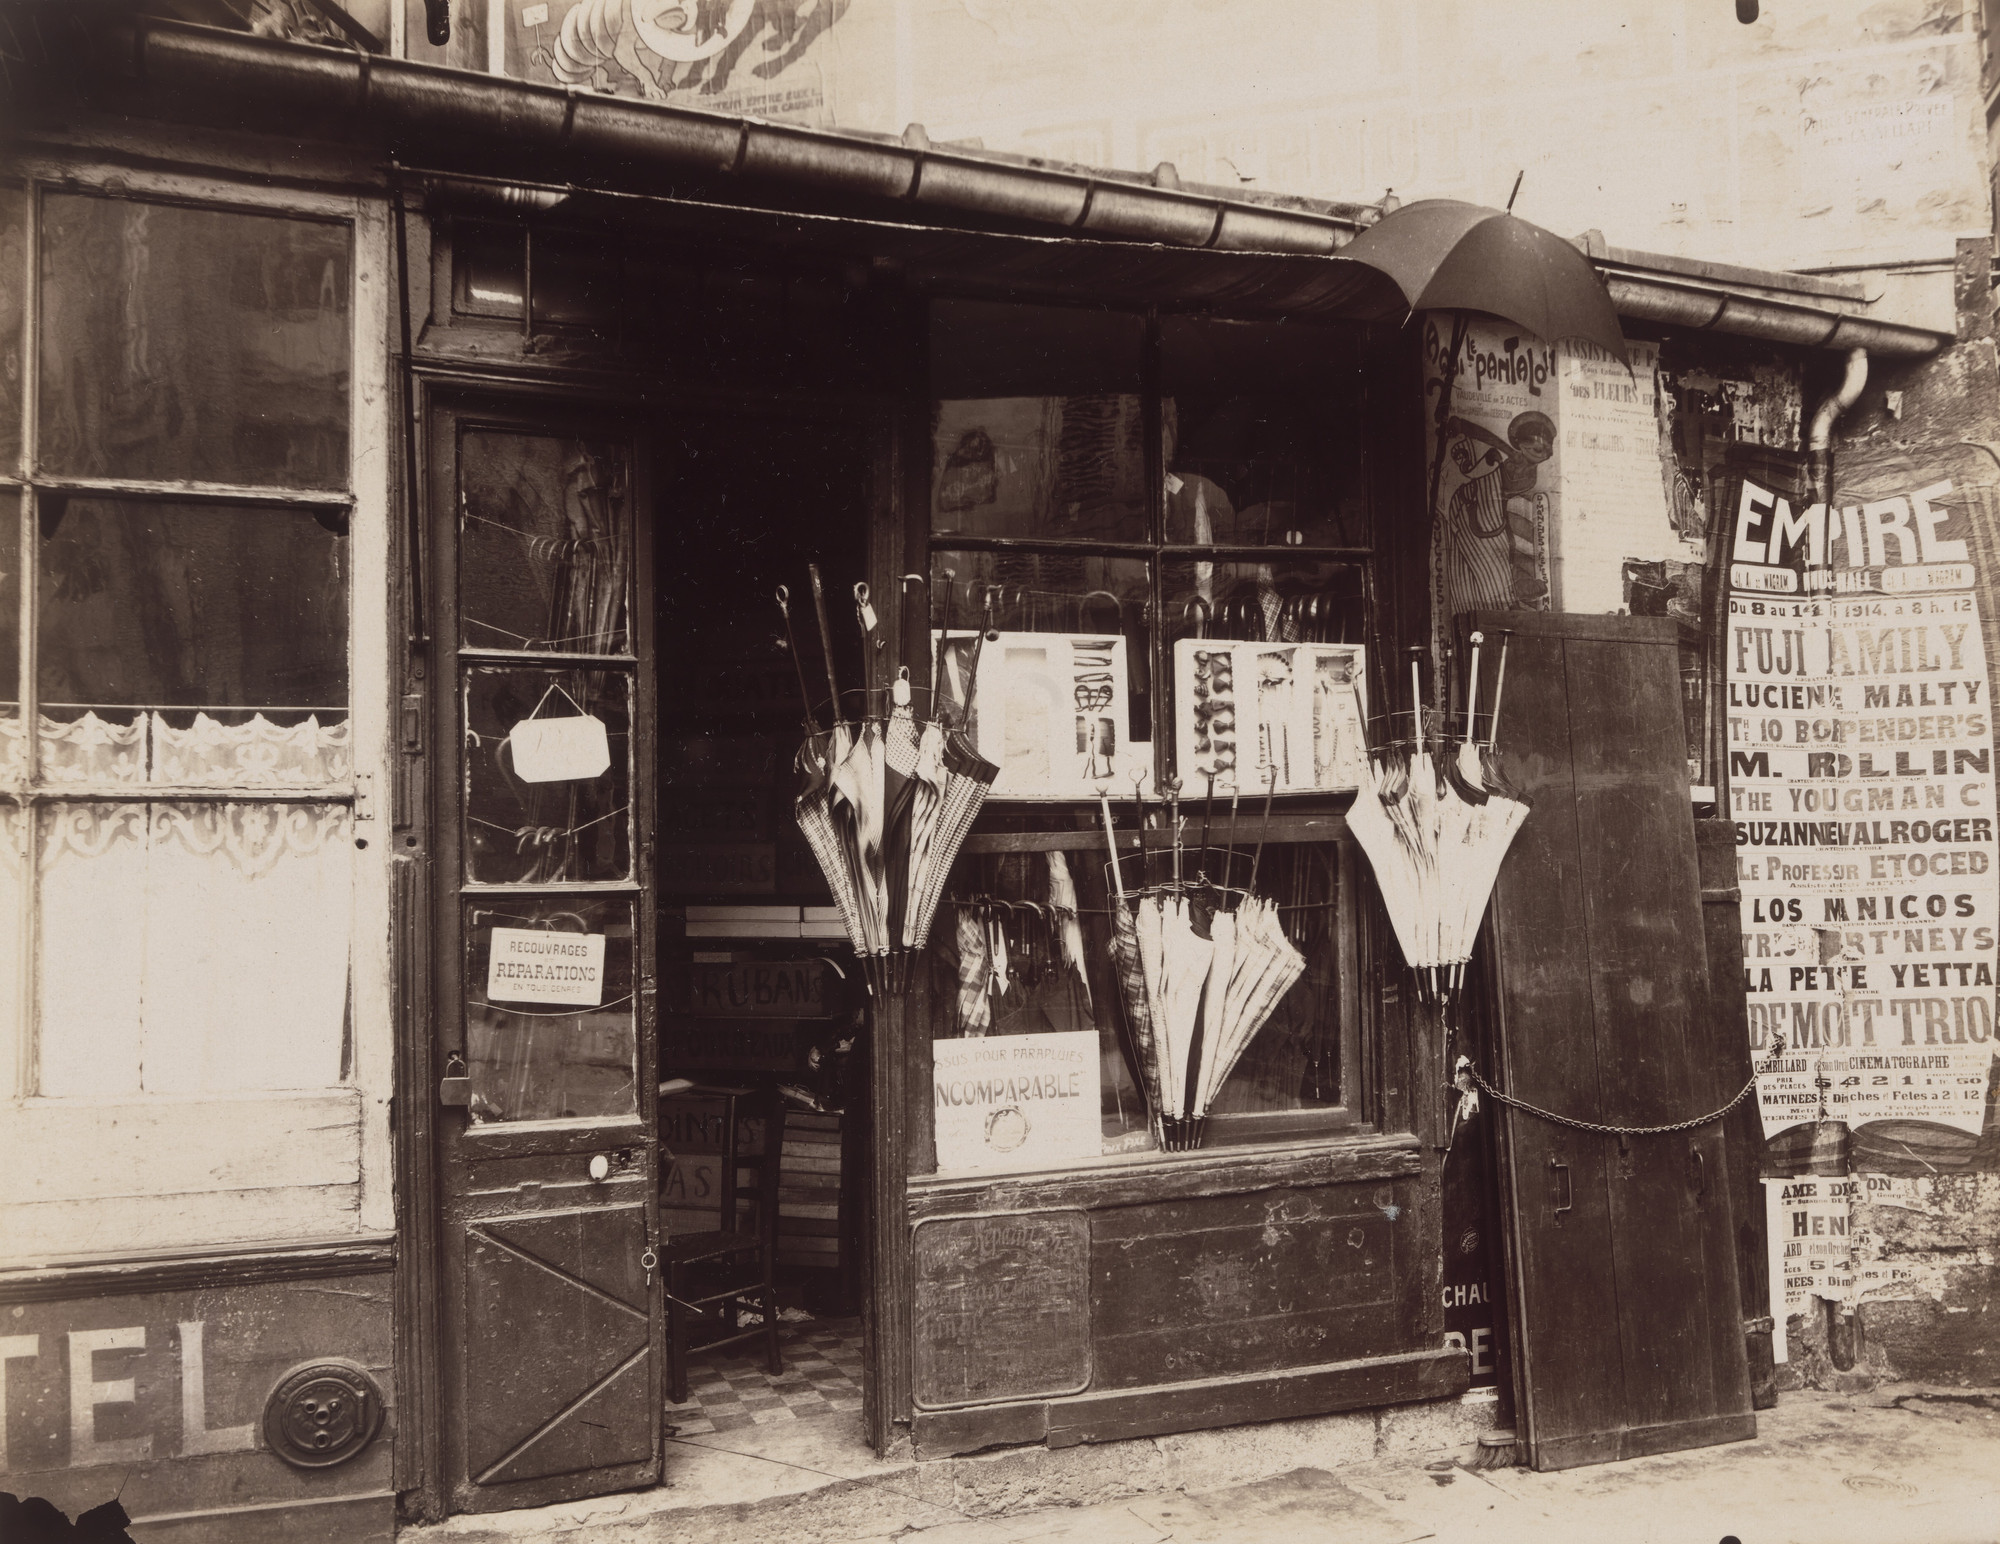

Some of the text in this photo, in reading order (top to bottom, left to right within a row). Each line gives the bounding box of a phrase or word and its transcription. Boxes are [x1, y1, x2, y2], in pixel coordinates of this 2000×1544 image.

[1506, 395, 1529, 407] ACTES
[1593, 381, 1638, 404] FLEURS
[1733, 479, 1969, 566] EMPIRE
[1730, 600, 1747, 614] Du
[1751, 602, 1766, 615] 8
[1770, 606, 1786, 616] au
[1911, 602, 1923, 615] 8
[1734, 626, 1806, 676] FUJI
[1864, 680, 1982, 710] MALTY
[1761, 718, 1783, 742] 10
[1730, 750, 1783, 778] M.
[1731, 787, 1772, 812] THE
[1737, 856, 1760, 881] LE
[1869, 850, 1989, 880] ETOCED
[1753, 897, 1803, 923] LOS
[510, 940, 588, 958] RECOUVRAGES
[496, 960, 596, 982] RÉPARATIONS
[1745, 966, 1774, 993] LA
[1890, 962, 1993, 990] YETTA
[701, 966, 824, 1011] RUBANS
[1889, 995, 1992, 1048] TRIO
[974, 1049, 1007, 1063] POUR
[1013, 1047, 1083, 1064] PARAPLUIES
[1849, 1055, 1950, 1071] CINEMATOGRAPHE
[936, 1071, 1081, 1108] NCOMPARABLE
[1871, 1075, 1889, 1086] 2
[1901, 1075, 1914, 1086] 1
[1762, 1093, 1818, 1106] MATINEES
[1793, 1210, 1850, 1238] HEN
[1783, 1242, 1802, 1258] ARD
[1809, 1260, 1826, 1271] 5
